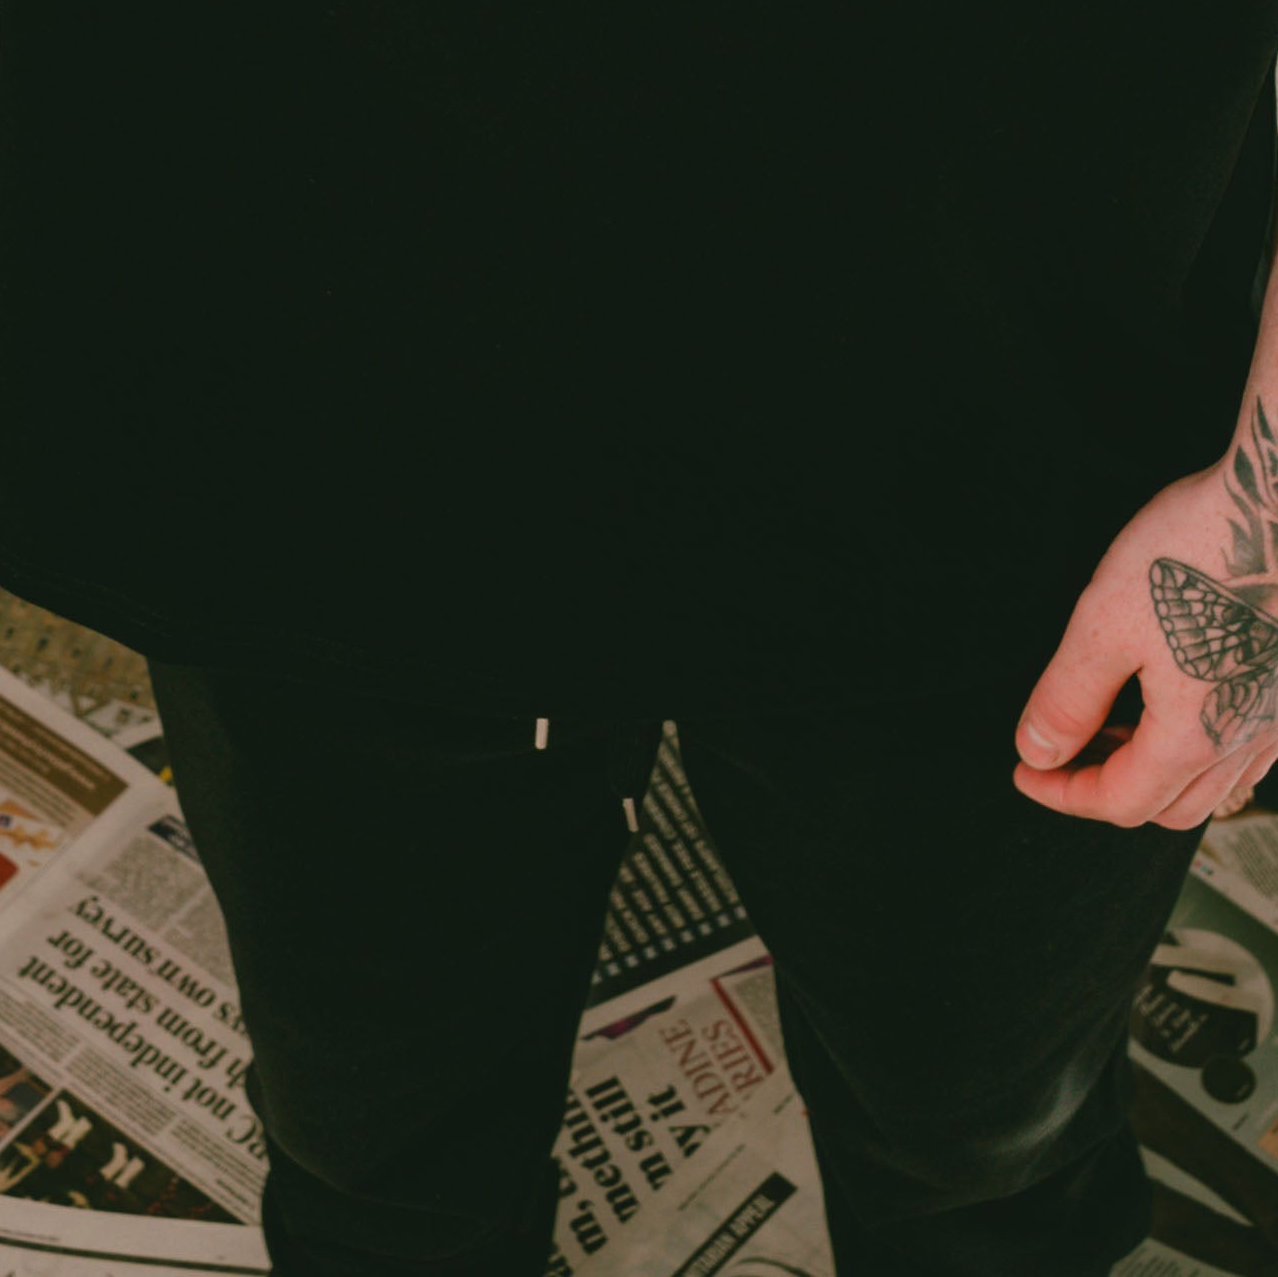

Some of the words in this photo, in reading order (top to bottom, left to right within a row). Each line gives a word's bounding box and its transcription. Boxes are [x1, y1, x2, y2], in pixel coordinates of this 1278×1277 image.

[46, 930, 94, 970] for
[74, 895, 154, 965] survey
[90, 960, 158, 1013] state
[155, 959, 216, 1007] own
[18, 956, 186, 1091] independent
[155, 1007, 227, 1070] from
[181, 1077, 236, 1121] not
[585, 1076, 652, 1151] still
